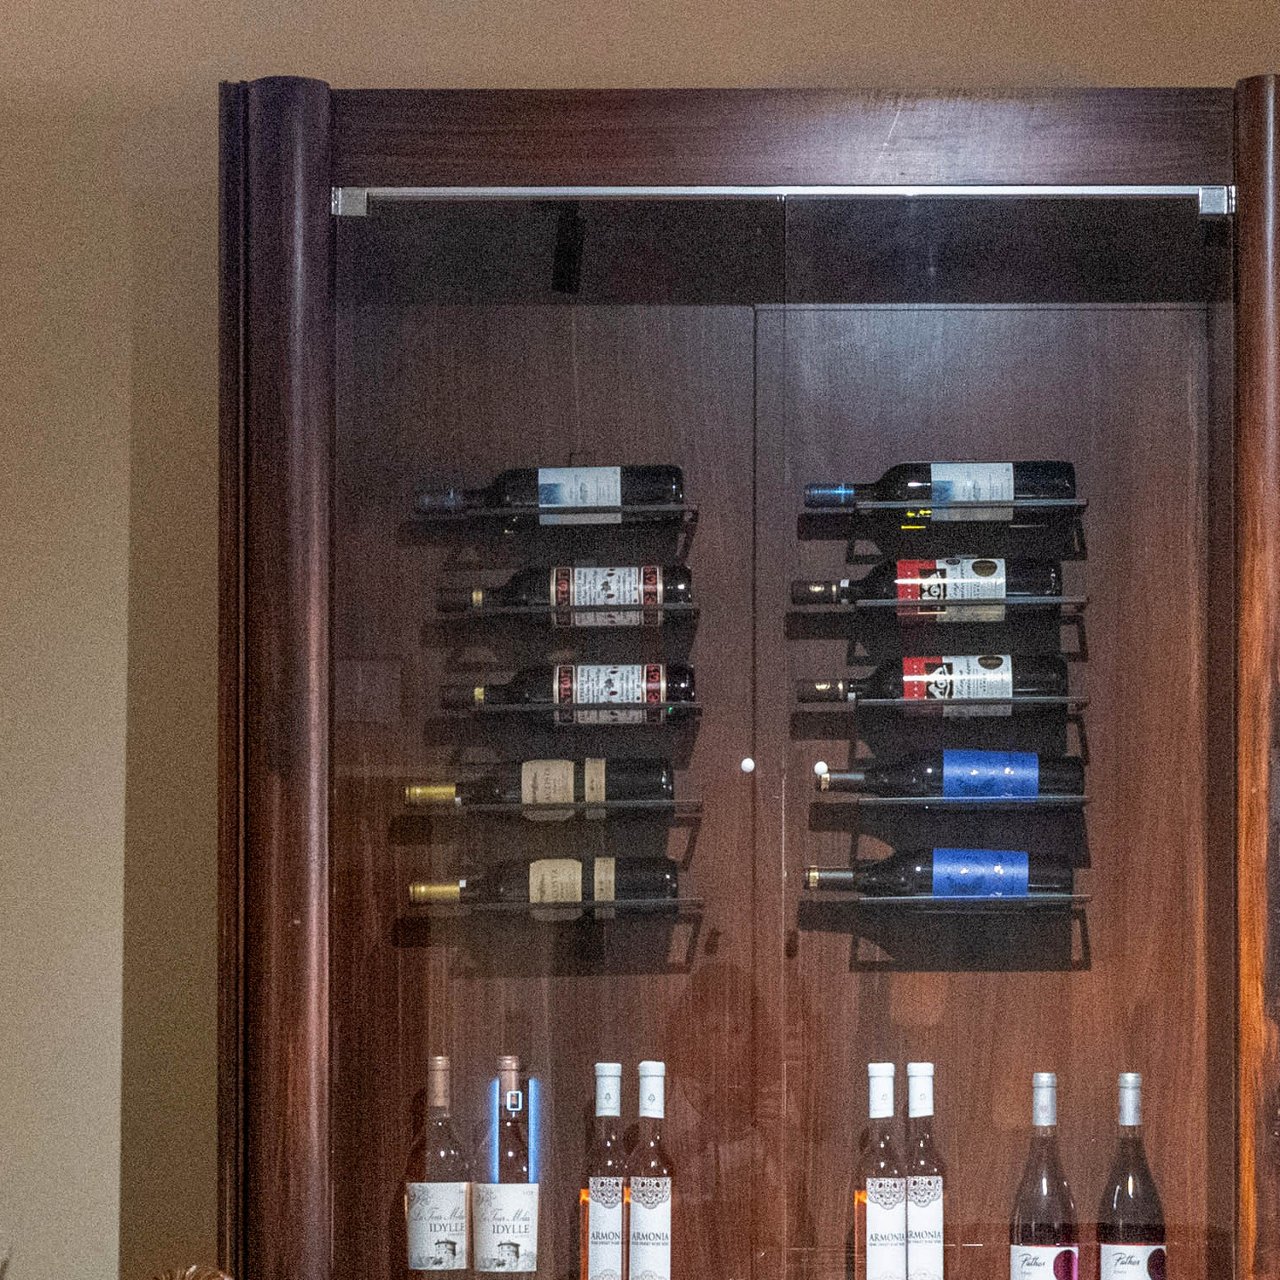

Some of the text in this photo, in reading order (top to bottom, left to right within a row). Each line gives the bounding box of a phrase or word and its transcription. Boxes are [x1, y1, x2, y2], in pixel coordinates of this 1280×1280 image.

[429, 1222, 465, 1233] IDYLLE
[492, 1224, 530, 1234] IDYLLE
[590, 1231, 620, 1240] ARMON
[632, 1231, 669, 1241] ARMONIA
